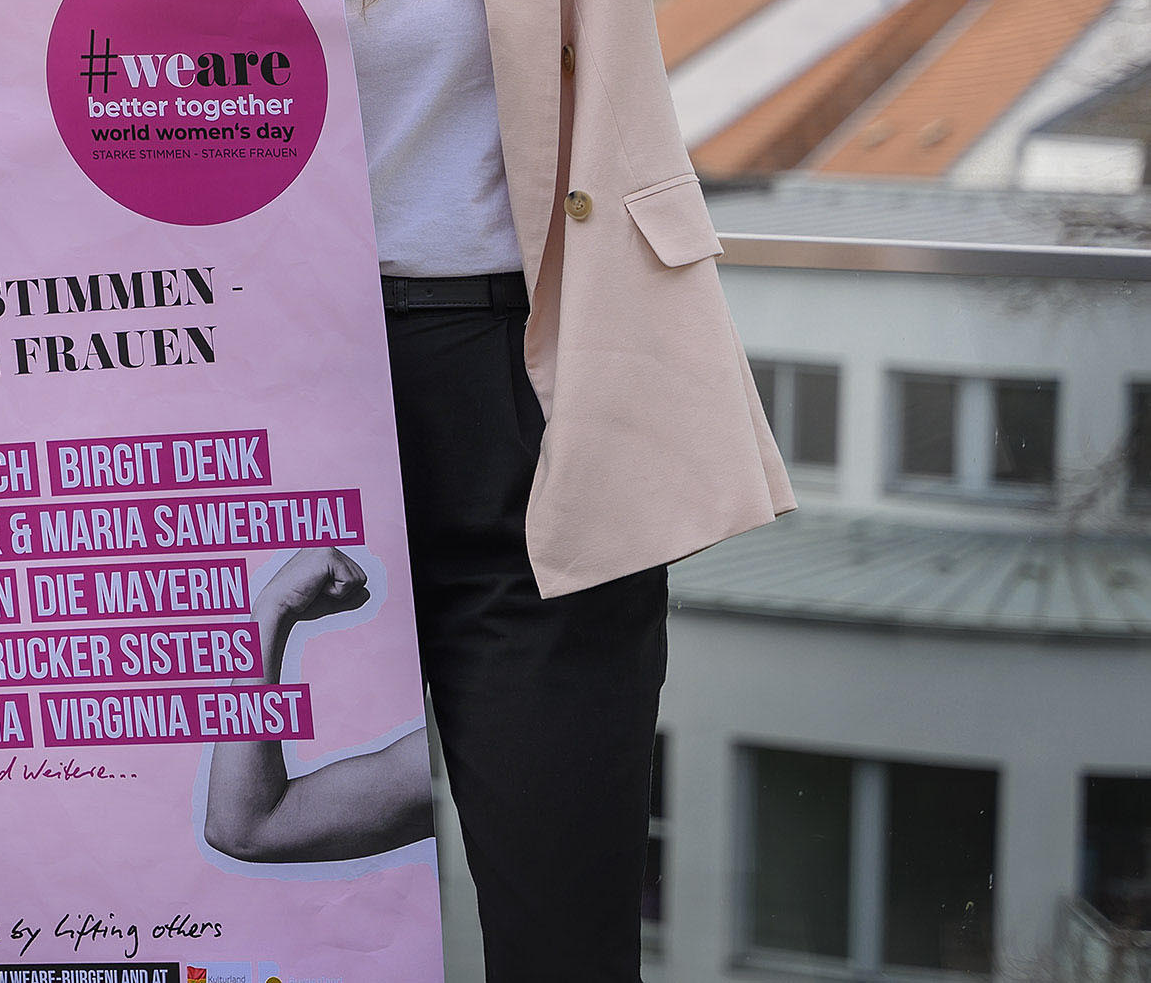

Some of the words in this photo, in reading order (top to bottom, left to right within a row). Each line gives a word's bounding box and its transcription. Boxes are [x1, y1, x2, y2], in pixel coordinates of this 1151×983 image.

[80, 29, 291, 94] #weare
[87, 96, 169, 118] better
[175, 93, 294, 121] together
[91, 124, 150, 142] world
[155, 123, 251, 141] women's
[256, 122, 296, 143] day
[92, 149, 136, 160] STARKE
[139, 149, 191, 160] STIMMEN
[201, 148, 246, 159] STARKE
[249, 147, 297, 158] FRAUEN
[10, 325, 217, 376] FRAUEN
[58, 441, 163, 489] BIRGIT
[172, 436, 264, 483] DENK
[9, 512, 33, 554] &
[39, 506, 148, 553] MARIA
[153, 496, 358, 548] SAWERTHAL
[34, 573, 88, 616] DIE
[94, 566, 245, 614] MAYERIN
[119, 629, 255, 676] SISTERS
[46, 694, 191, 740] VIRGINIA
[197, 690, 303, 735] ERNST
[9, 918, 42, 957] by
[53, 913, 140, 958] lifting
[152, 913, 223, 939] others
